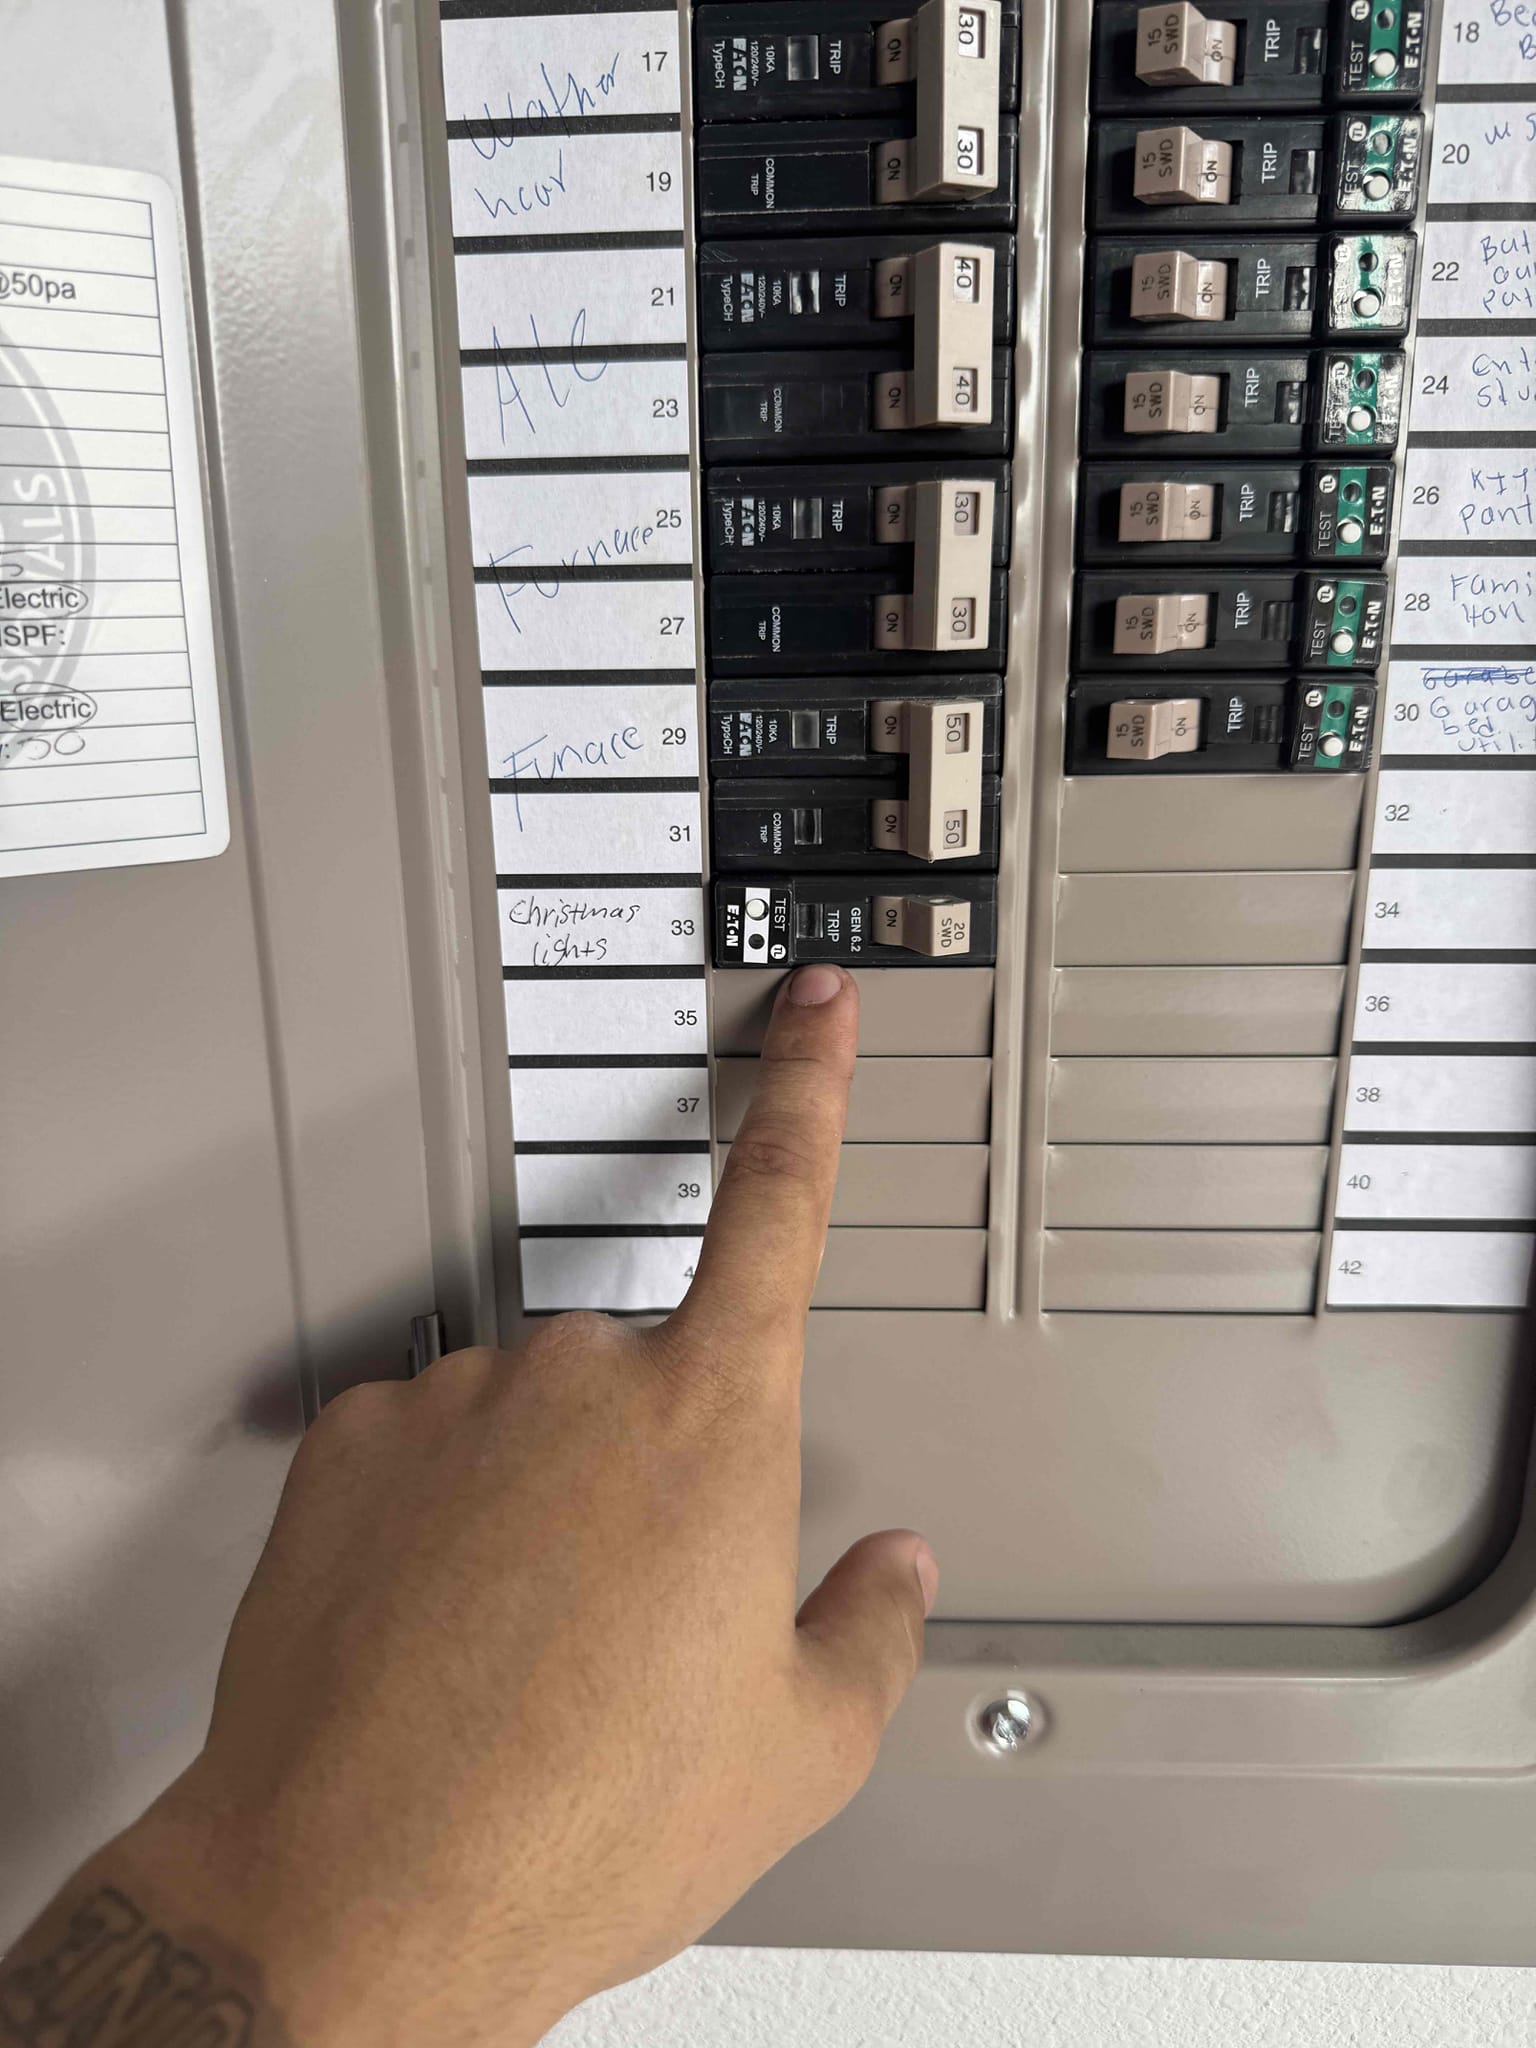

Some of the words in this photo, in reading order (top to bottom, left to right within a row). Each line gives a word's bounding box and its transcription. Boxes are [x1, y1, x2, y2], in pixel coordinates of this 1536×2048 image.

[958, 14, 974, 46] 30
[1148, 28, 1161, 47] 15
[1165, 14, 1179, 53] SWD
[1265, 19, 1280, 61] TRIP
[1453, 21, 1480, 43] 18
[829, 40, 841, 75] TRIP
[888, 38, 900, 62] ON
[1211, 39, 1223, 62] ON
[642, 52, 668, 72] 17
[1349, 41, 1364, 85] TEST
[957, 138, 973, 169] 30
[1142, 152, 1156, 169] 15
[1159, 138, 1172, 177] SWD
[1262, 142, 1278, 184] TRIP
[1442, 143, 1470, 165] 20
[888, 158, 900, 181] ON
[1206, 160, 1217, 182] ON
[646, 172, 671, 192] 19
[751, 173, 759, 196] TRIP
[766, 158, 775, 209] COMMON
[956, 258, 972, 288] 40
[1158, 264, 1171, 299] SWD
[1256, 257, 1271, 298] TRIP
[1432, 261, 1460, 281] 22
[834, 274, 846, 307] TRIP
[890, 273, 902, 297] ON
[1141, 275, 1154, 291] 15
[1201, 281, 1213, 304] ON
[651, 287, 675, 306] 21
[955, 375, 970, 406] 40
[1245, 367, 1260, 408] TRIP
[1422, 376, 1449, 395] 24
[652, 399, 679, 418] 23
[889, 386, 900, 409] ON
[1133, 393, 1146, 409] 15
[1149, 382, 1162, 418] SWD
[1194, 395, 1205, 415] ON
[760, 401, 768, 423] TRIP
[773, 387, 783, 433] COMMON
[1240, 483, 1254, 522] TRIP
[1412, 486, 1440, 505] 26
[656, 509, 682, 528] 25
[831, 500, 843, 532] TRIP
[887, 503, 899, 525] ON
[954, 495, 969, 524] 30
[1130, 502, 1142, 517] 15
[1146, 491, 1159, 525] SWD
[1188, 500, 1200, 520] ON
[1318, 511, 1332, 550] TEST
[1234, 592, 1248, 629] TRIP
[1404, 593, 1431, 612] 28
[660, 617, 685, 635] 27
[758, 621, 766, 641] TRIP
[771, 606, 780, 653] COMMON
[886, 612, 898, 633] ON
[952, 606, 967, 633] 30
[1126, 616, 1138, 631] 15
[1141, 606, 1154, 640] SWD
[1184, 612, 1196, 633] ON
[0, 622, 66, 647] SPF:
[1310, 620, 1326, 658] TEST
[1, 698, 92, 721] Electric
[1227, 696, 1243, 733] TRIP
[1394, 703, 1420, 721] 30
[662, 728, 687, 745] 29
[826, 715, 837, 745] TRIP
[884, 715, 896, 736] ON
[946, 716, 962, 743] 50
[1116, 723, 1129, 738] 15
[1132, 714, 1145, 747] SWD
[1174, 716, 1187, 737] ON
[1298, 723, 1314, 760] TEST
[885, 814, 896, 834] ON
[1384, 804, 1410, 821] 32
[669, 825, 691, 842] 31
[772, 813, 782, 855] COMMON
[945, 819, 960, 845] 50
[509, 895, 641, 927] Christmas
[774, 898, 787, 932] TEST
[850, 907, 861, 934] GEN
[885, 909, 896, 928] ON
[1375, 902, 1400, 918] 34
[671, 919, 695, 936] 33
[828, 909, 840, 943] TRIP
[941, 918, 953, 948] SWD
[954, 922, 965, 941] 20
[850, 936, 861, 953] 6.2
[1365, 996, 1390, 1012] 36
[674, 1009, 698, 1026] 35
[677, 1097, 700, 1113] 37
[1356, 1087, 1381, 1103] 38
[678, 1183, 701, 1198] 39
[1347, 1174, 1371, 1190] 40
[1338, 1260, 1362, 1275] 42
